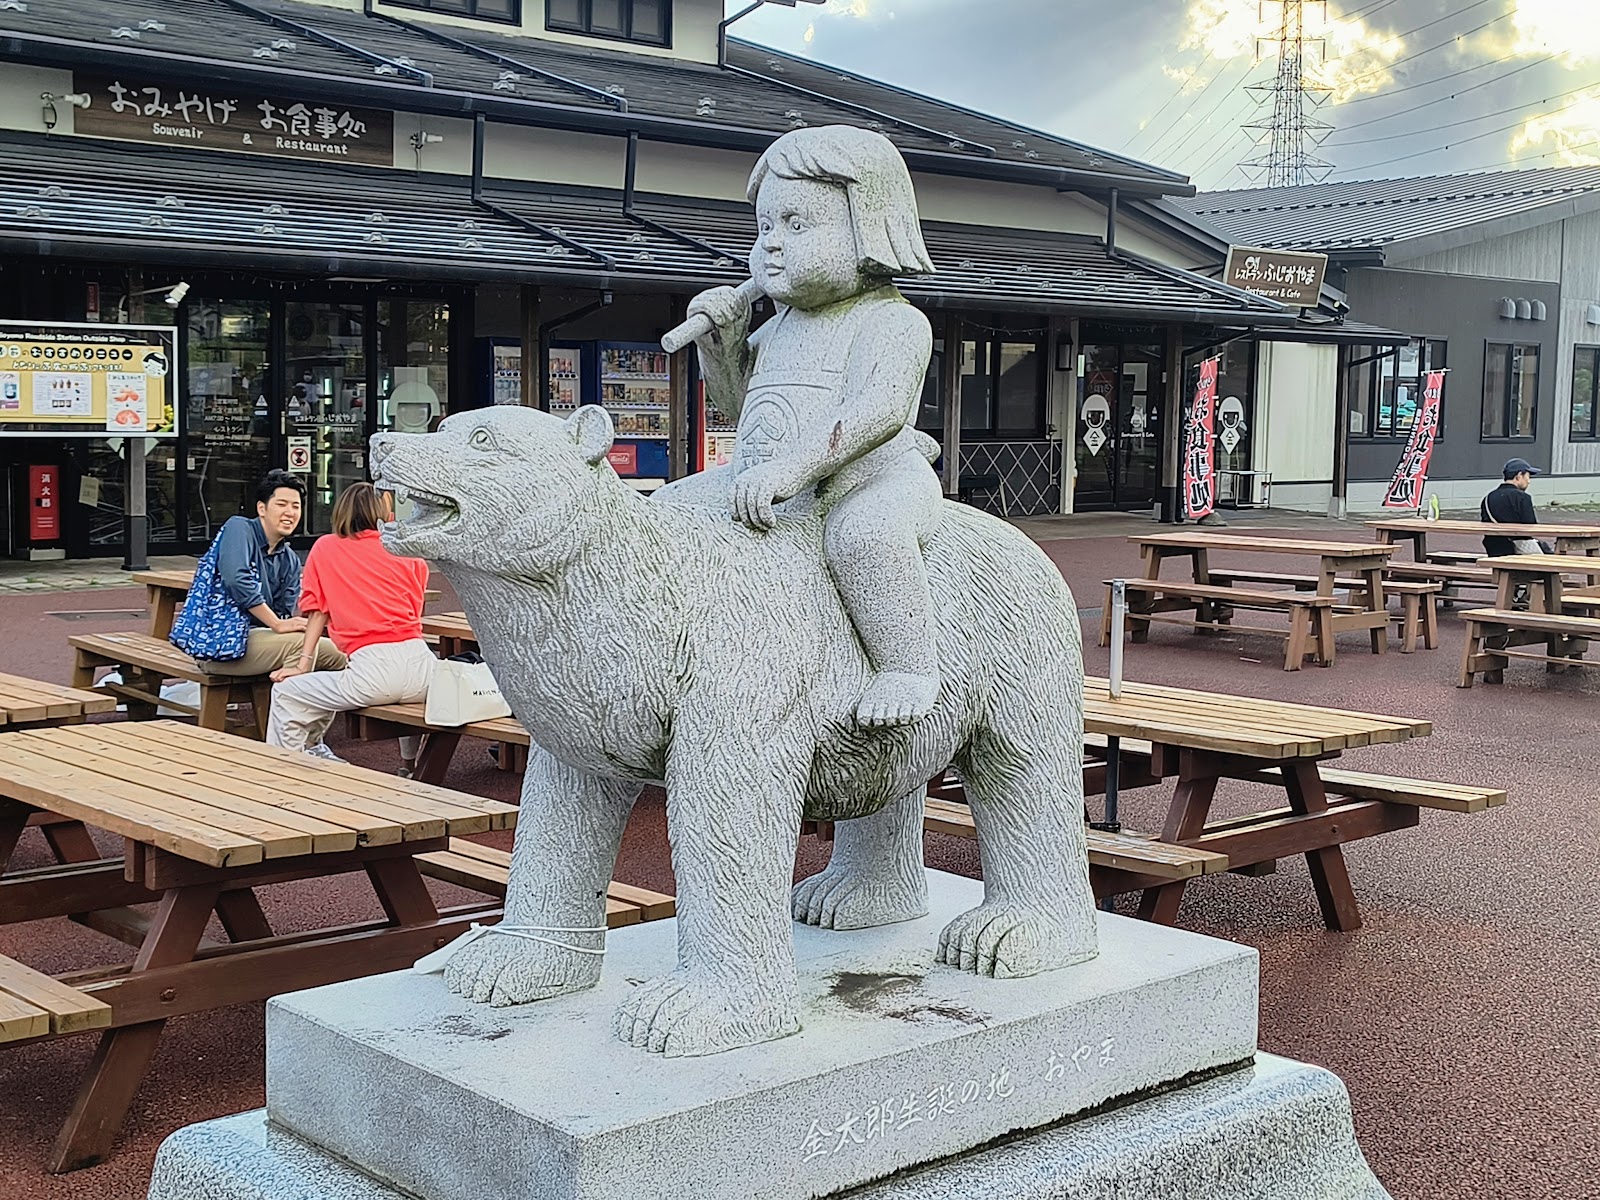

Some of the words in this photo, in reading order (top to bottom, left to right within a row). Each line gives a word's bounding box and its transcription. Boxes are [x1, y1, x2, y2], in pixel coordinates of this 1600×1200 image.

[107, 80, 239, 126] おみやげ
[257, 99, 368, 139] お食事処
[152, 122, 204, 139] Souvenir
[242, 132, 253, 146] &
[275, 135, 349, 155] Restaurant
[1286, 288, 1301, 298] Cafe
[799, 1066, 1016, 1164] 金太郎生誕の地
[1044, 1036, 1117, 1082] おやま
